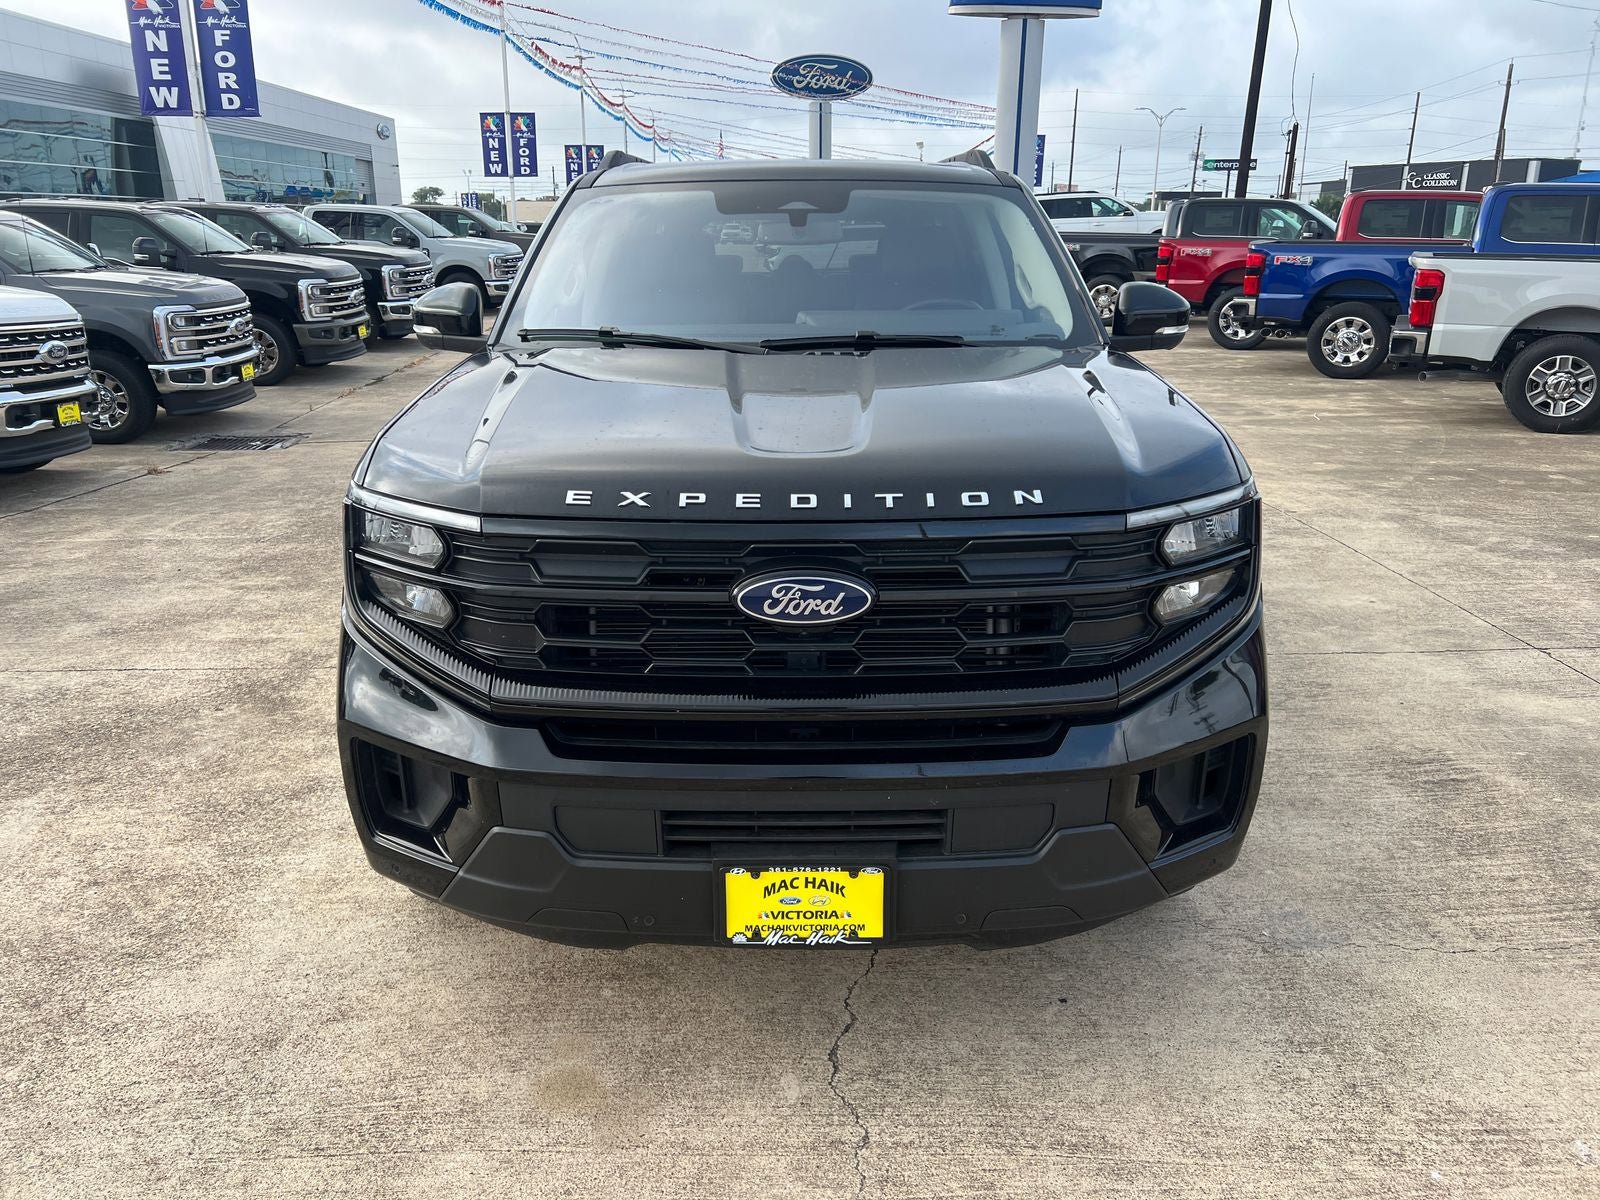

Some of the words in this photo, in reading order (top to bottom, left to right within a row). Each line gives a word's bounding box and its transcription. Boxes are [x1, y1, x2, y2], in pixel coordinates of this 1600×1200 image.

[144, 30, 179, 108] NEW
[213, 29, 240, 110] FORD
[793, 62, 857, 93] Ford
[488, 138, 502, 174] NEW
[519, 138, 530, 175] FORD
[1207, 161, 1256, 170] enterpe
[1423, 179, 1458, 187] COLLISION
[1180, 248, 1212, 256] FX4
[1274, 256, 1313, 265] FX4
[565, 489, 1044, 508] EXPEDITION
[763, 583, 846, 616] Ford
[763, 877, 800, 898] MAC
[804, 877, 846, 898] HAIK
[770, 910, 839, 920] VICTORIA
[764, 929, 804, 946] Mac
[805, 929, 847, 946] Haik
